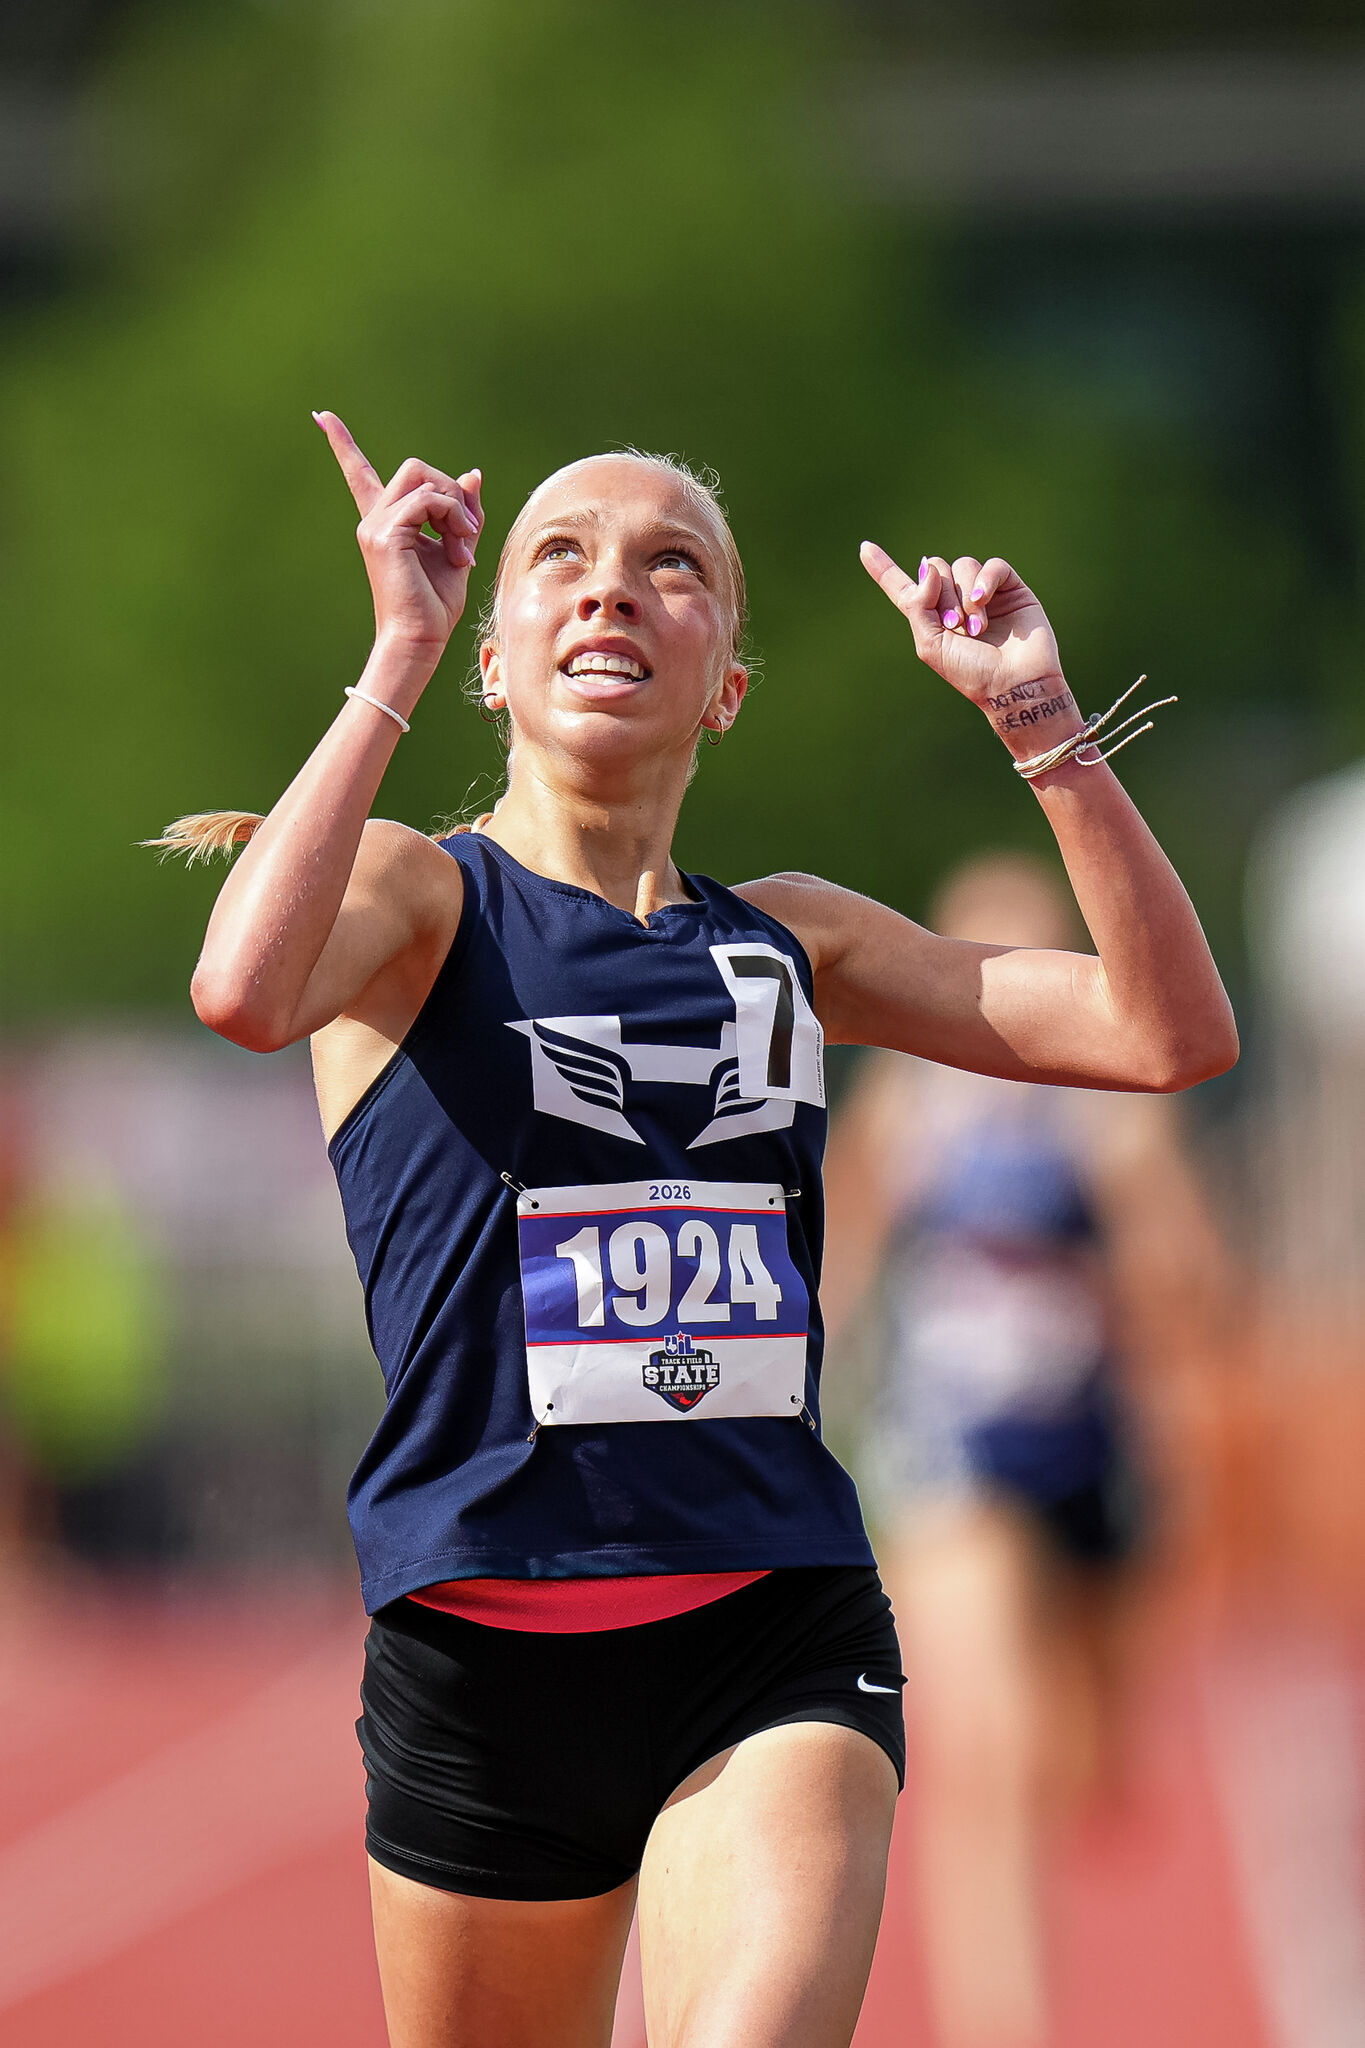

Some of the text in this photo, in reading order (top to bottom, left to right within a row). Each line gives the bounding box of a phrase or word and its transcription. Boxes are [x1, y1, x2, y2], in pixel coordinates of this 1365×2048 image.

[987, 694, 1009, 712] DO
[996, 714, 1021, 733] BE
[727, 955, 794, 1089] 7
[648, 1184, 691, 1201] 2026
[555, 1219, 783, 1328] 1924
[644, 1365, 718, 1385] STATE
[659, 1384, 706, 1392] CHAMPIONSHIPS
